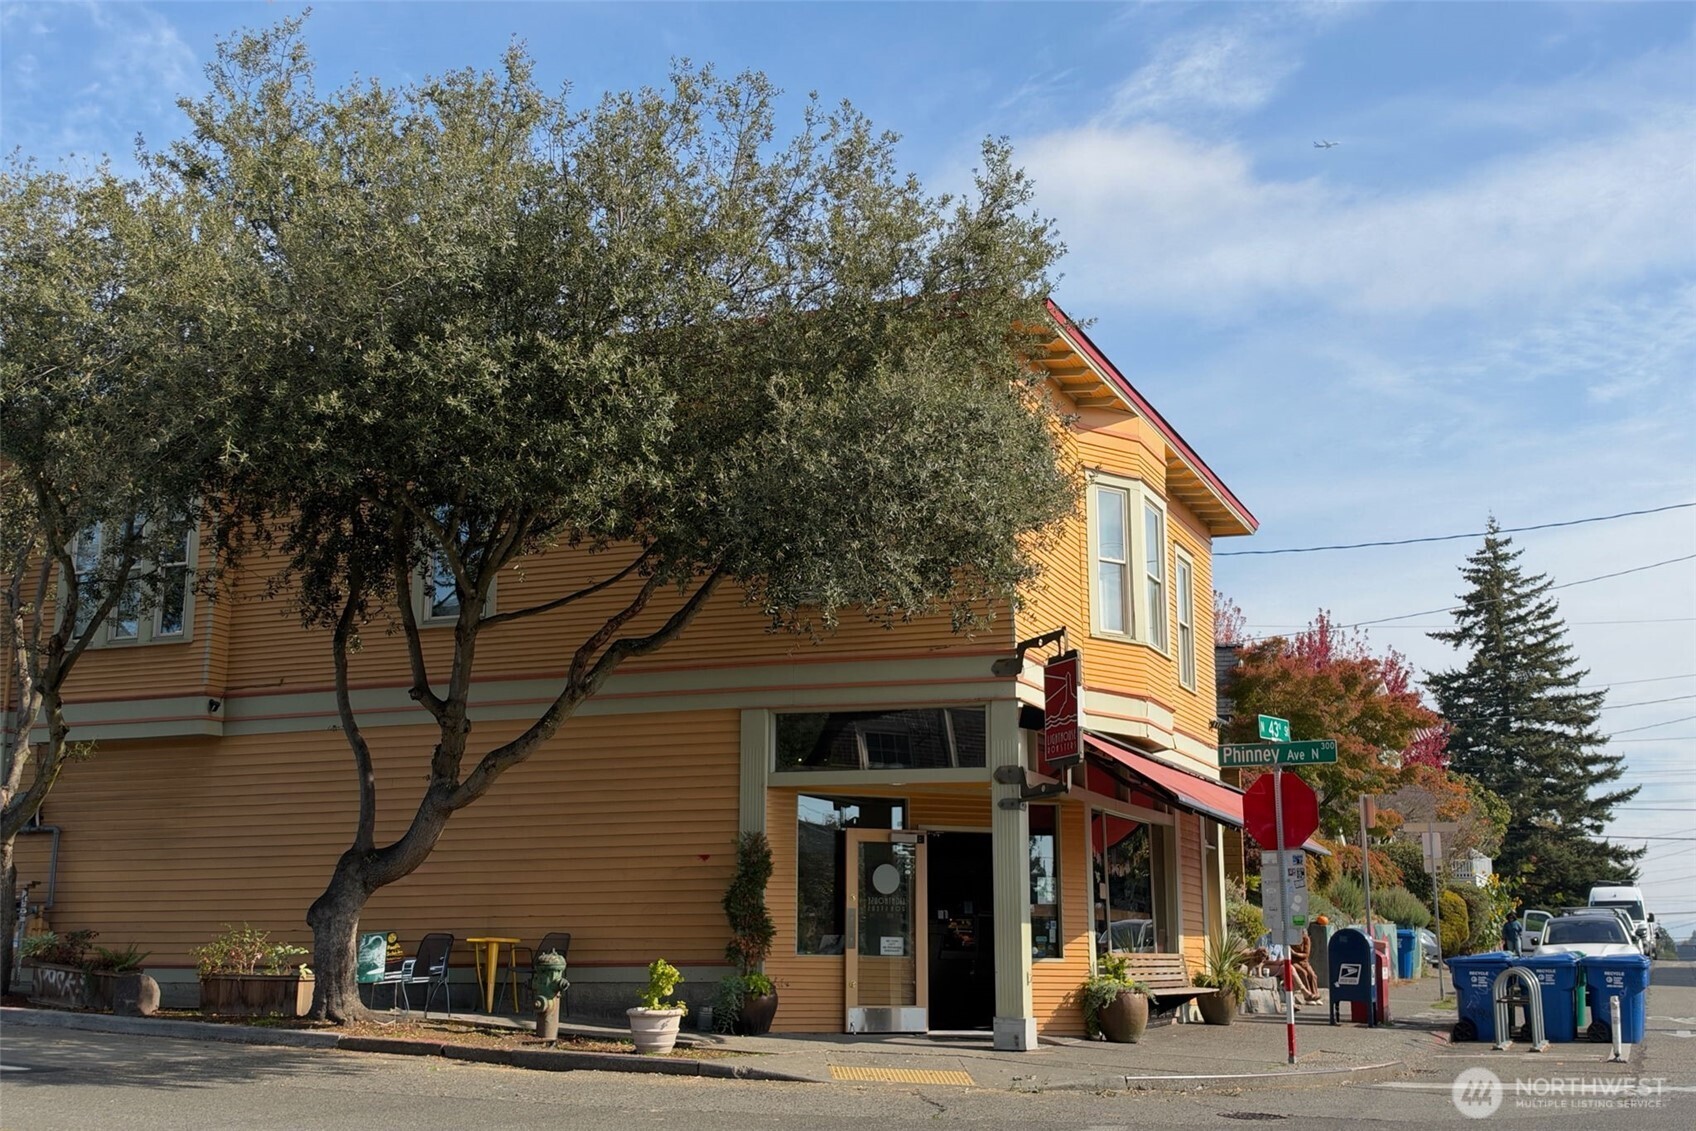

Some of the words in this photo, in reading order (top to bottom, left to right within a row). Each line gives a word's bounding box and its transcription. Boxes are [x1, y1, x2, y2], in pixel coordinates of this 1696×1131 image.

[1223, 746, 1280, 763] Phinney
[1287, 749, 1305, 760] Ave
[1311, 748, 1319, 759] N
[1321, 742, 1335, 750] 300
